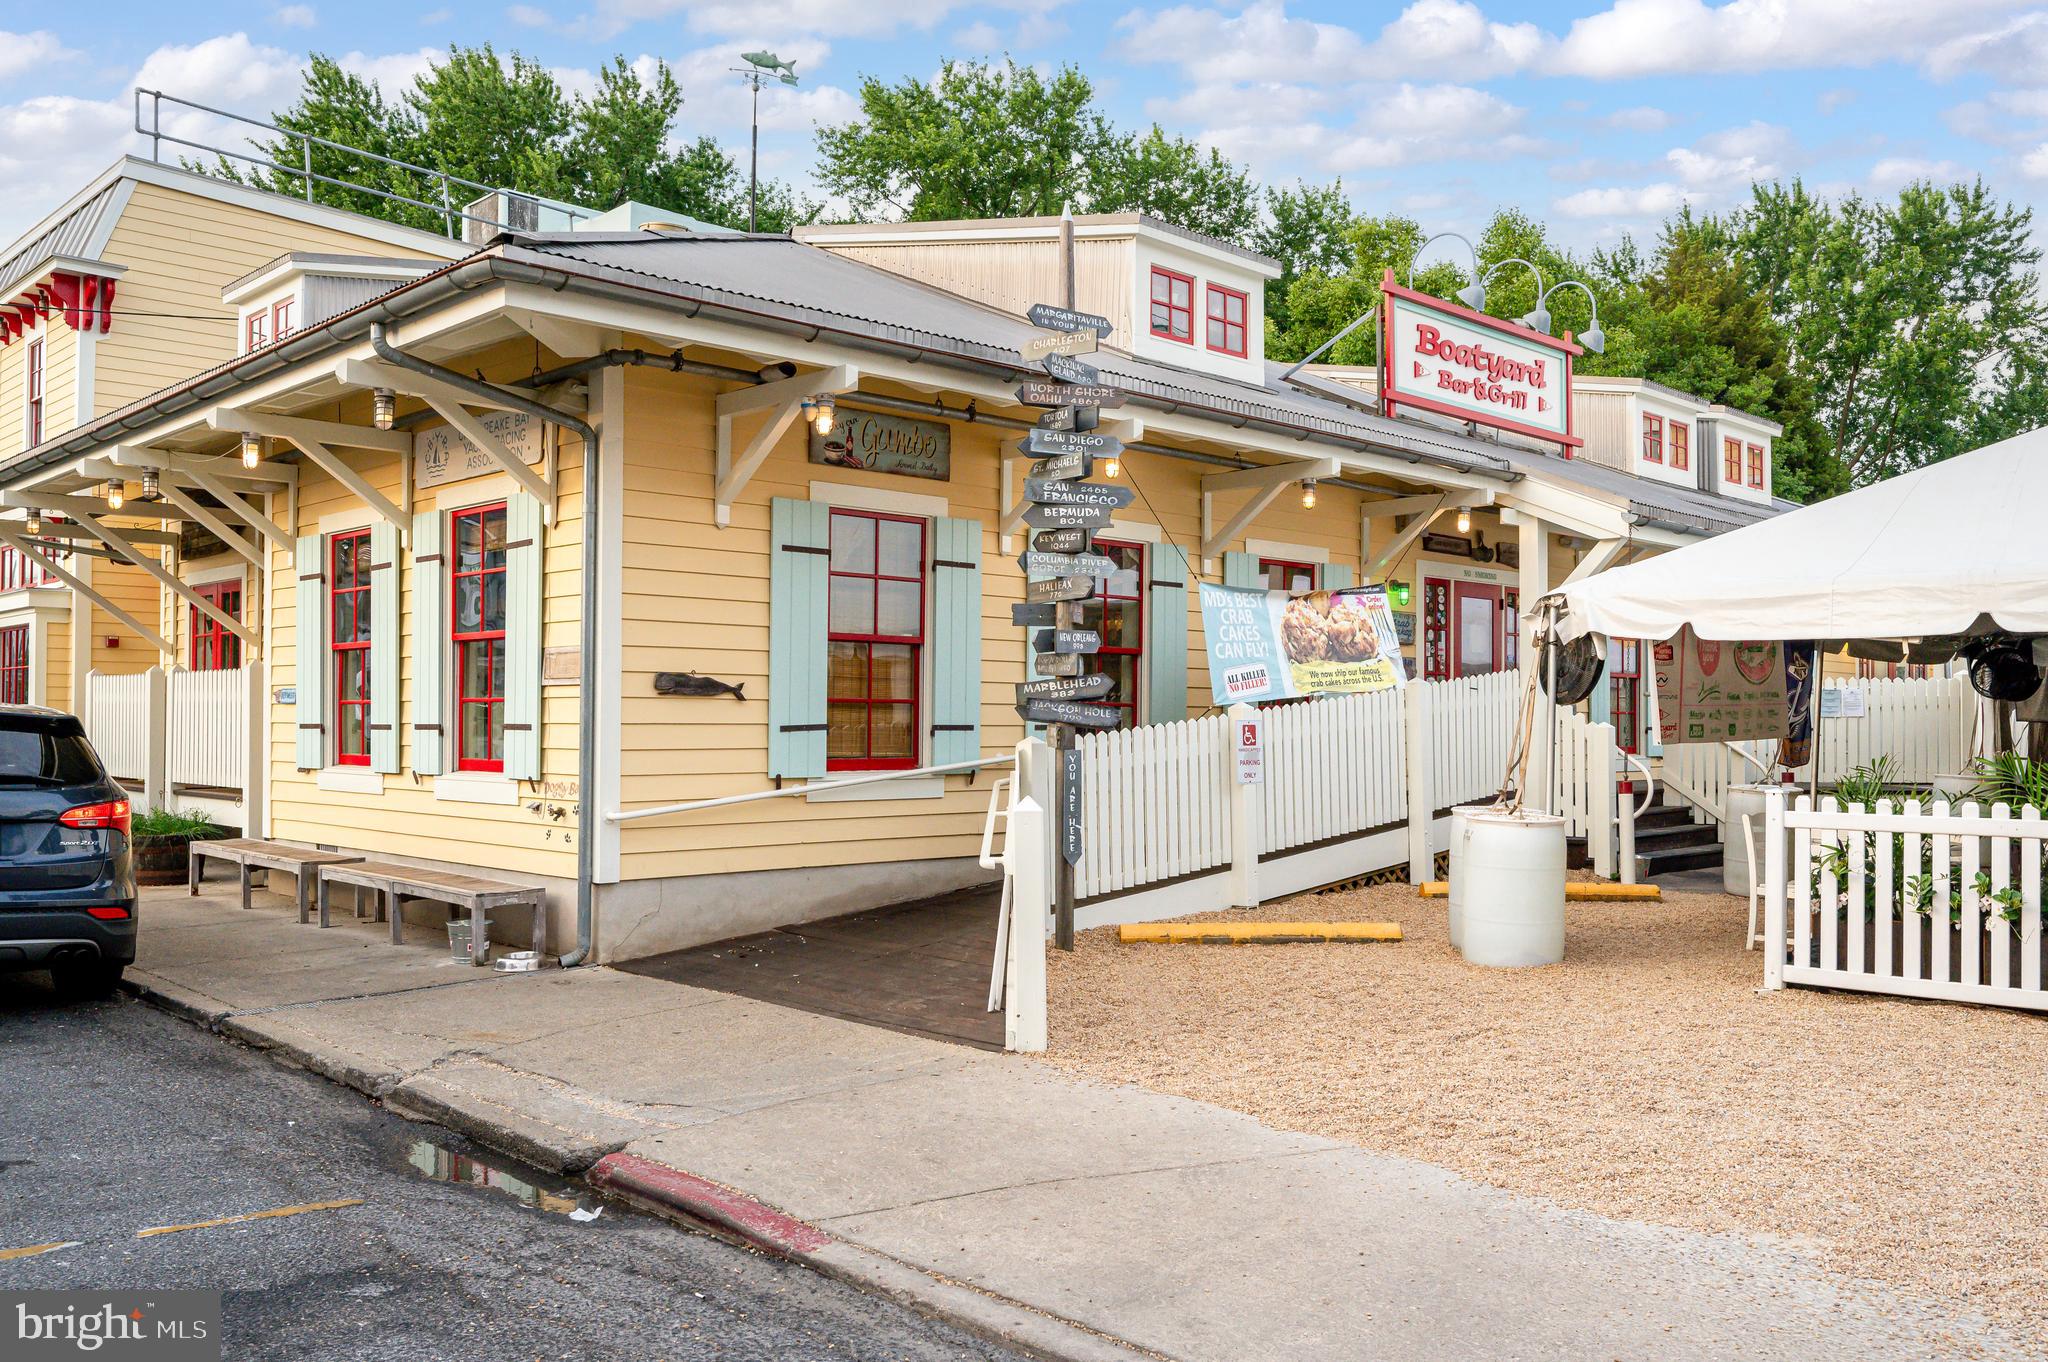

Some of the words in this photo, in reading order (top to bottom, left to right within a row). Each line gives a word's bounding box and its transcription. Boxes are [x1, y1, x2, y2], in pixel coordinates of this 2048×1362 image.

[1035, 306, 1109, 328] MARGARITAVILLE
[1052, 319, 1075, 329] YOUR
[1033, 332, 1092, 350] CHARLESTON
[1415, 323, 1547, 389] Boatyard
[1051, 364, 1076, 379] ISLAND
[1030, 383, 1071, 395] NORTH
[1074, 387, 1116, 398] SHORE
[1030, 393, 1062, 404] OAHU
[861, 415, 937, 469] Gumbo
[1043, 433, 1066, 443] SAN
[1069, 434, 1104, 446] DIEGO
[1045, 455, 1080, 471] MICHAELS
[1043, 482, 1070, 492] SAN
[1043, 491, 1118, 506] FRANCISCO
[1043, 507, 1100, 518] BERMUDA
[1059, 517, 1084, 526] 804
[1039, 534, 1056, 543] KEY
[1057, 533, 1082, 542] WEST
[1031, 554, 1079, 565] COLUMBIA
[1081, 559, 1108, 567] RIVER
[1031, 563, 1066, 574] GORGE
[1039, 578, 1073, 593] HALIFAX
[1233, 592, 1264, 608] BEST
[1220, 608, 1254, 625] CRAB
[1059, 632, 1072, 642] NEW
[1072, 633, 1097, 643] ORLEANS
[1219, 624, 1261, 641] CAKES
[1215, 641, 1244, 659] CAN
[1245, 641, 1270, 658] FLY!
[1227, 674, 1240, 684] ALL
[1240, 669, 1267, 681] KILLER
[1309, 670, 1320, 678] We
[1334, 668, 1347, 677] ship
[1358, 667, 1381, 675] famous
[1023, 676, 1101, 694] MARBLEHEAD
[1229, 683, 1240, 693] NO
[1240, 677, 1268, 691] FILLER!
[1310, 680, 1324, 688] crab
[1324, 678, 1342, 687] cakes
[1032, 701, 1081, 714] JACKSON
[1084, 707, 1112, 718] HOLE
[1068, 755, 1077, 780] YOU
[1068, 817, 1077, 852] HERE
